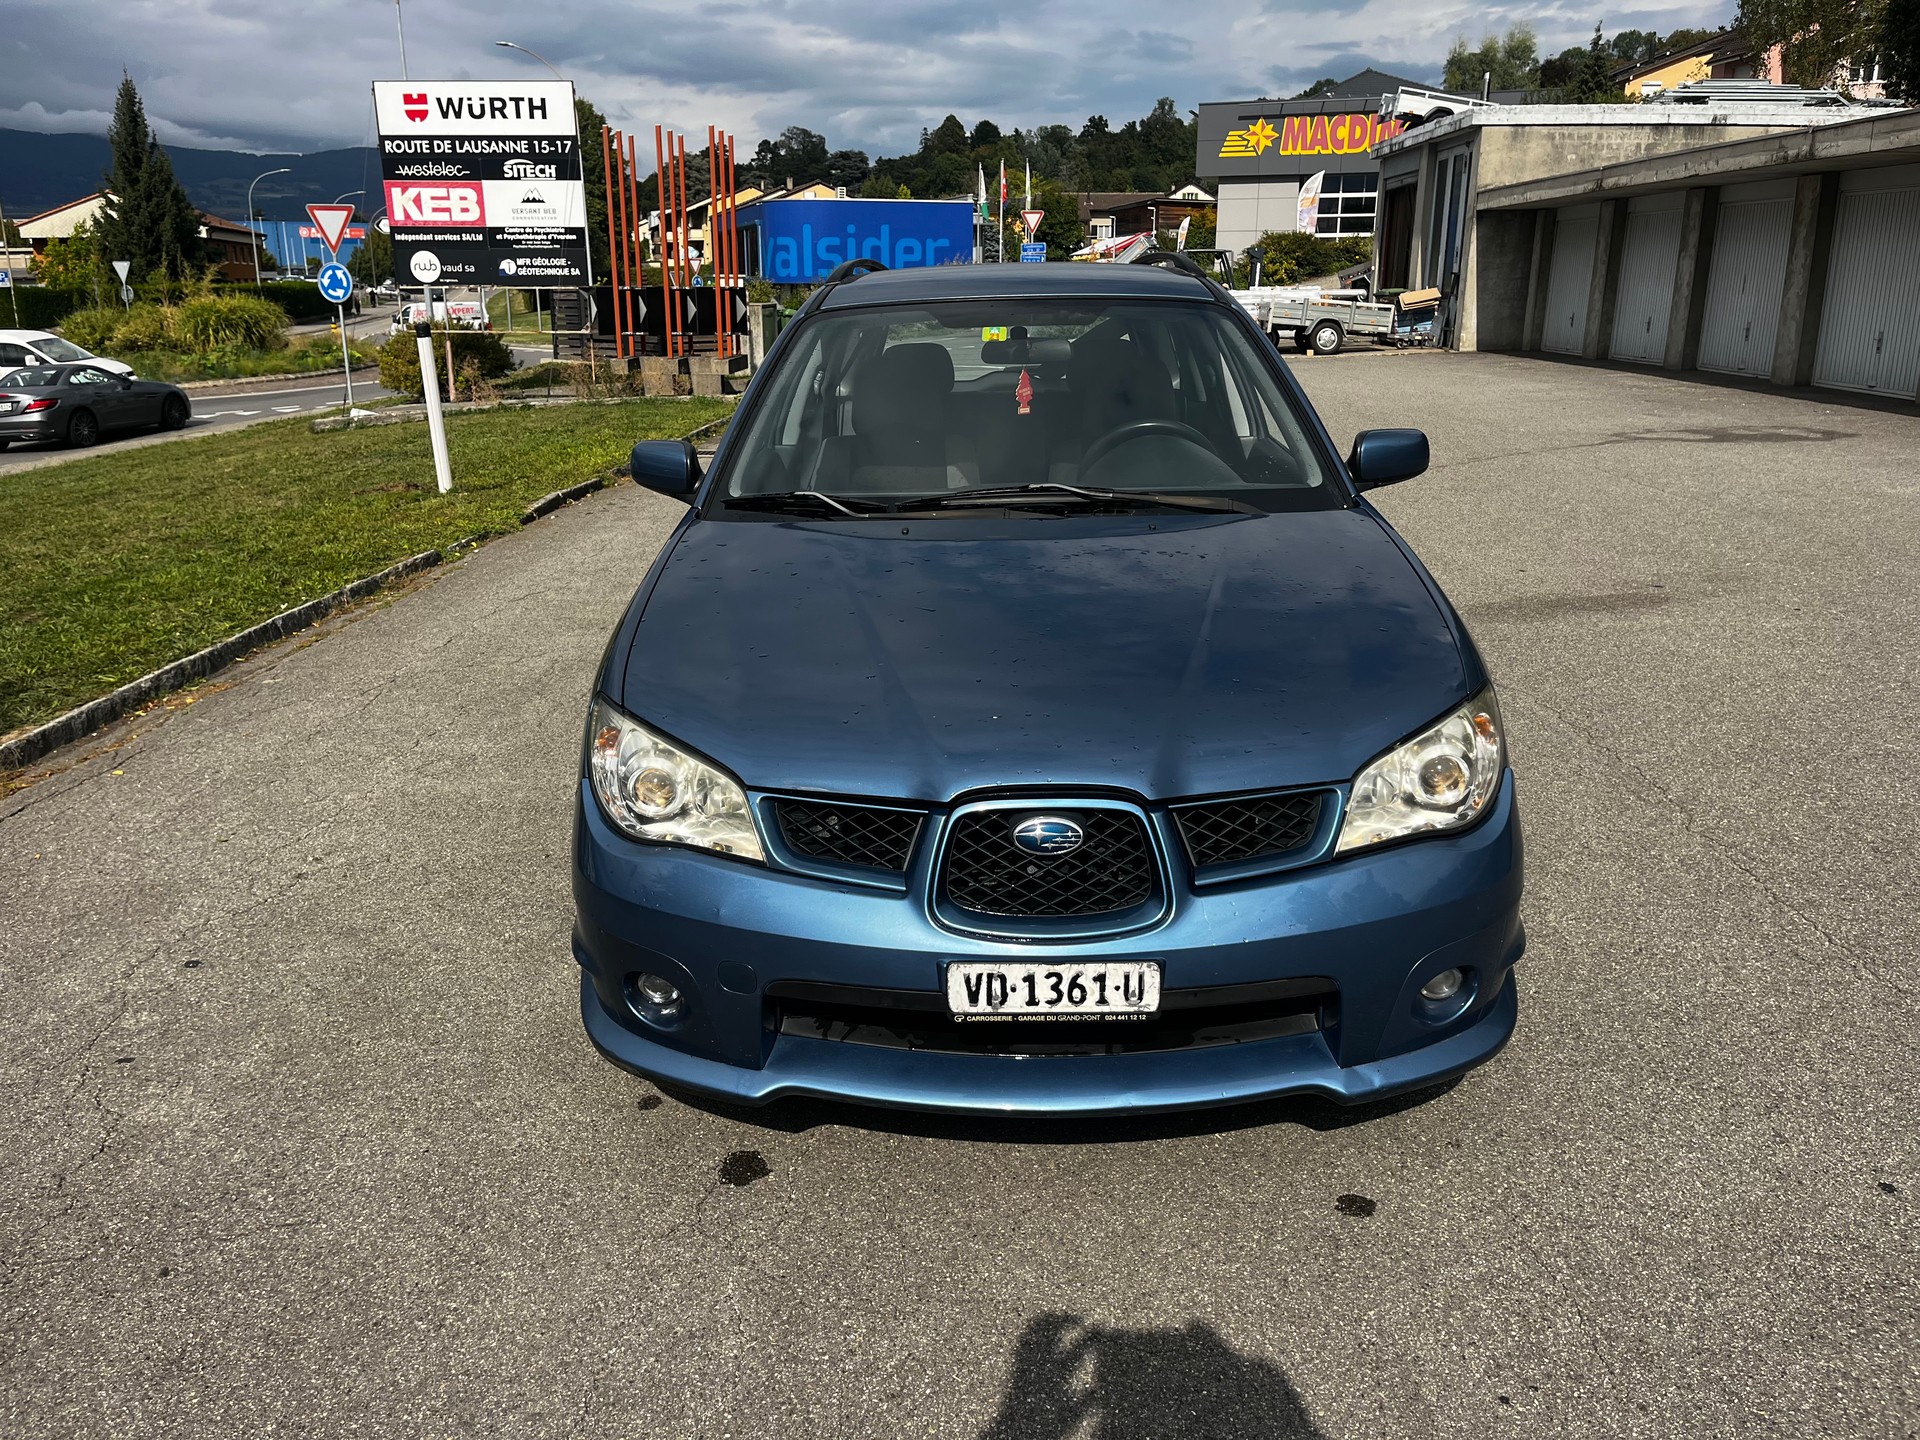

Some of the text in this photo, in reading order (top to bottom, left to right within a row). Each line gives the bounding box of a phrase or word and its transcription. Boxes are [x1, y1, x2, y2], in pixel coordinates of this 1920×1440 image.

[436, 97, 548, 120] WÜRTH
[384, 140, 572, 154] ROUTE DE LAUSANNE 15-17
[396, 161, 470, 177] westelec
[503, 164, 556, 178] SITECH
[390, 187, 480, 222] KEB
[442, 263, 463, 272] vaud
[516, 258, 531, 266] MFR
[532, 257, 566, 266] GÉOLOGIE
[517, 267, 581, 276] GÉOTECHNIQUE SA
